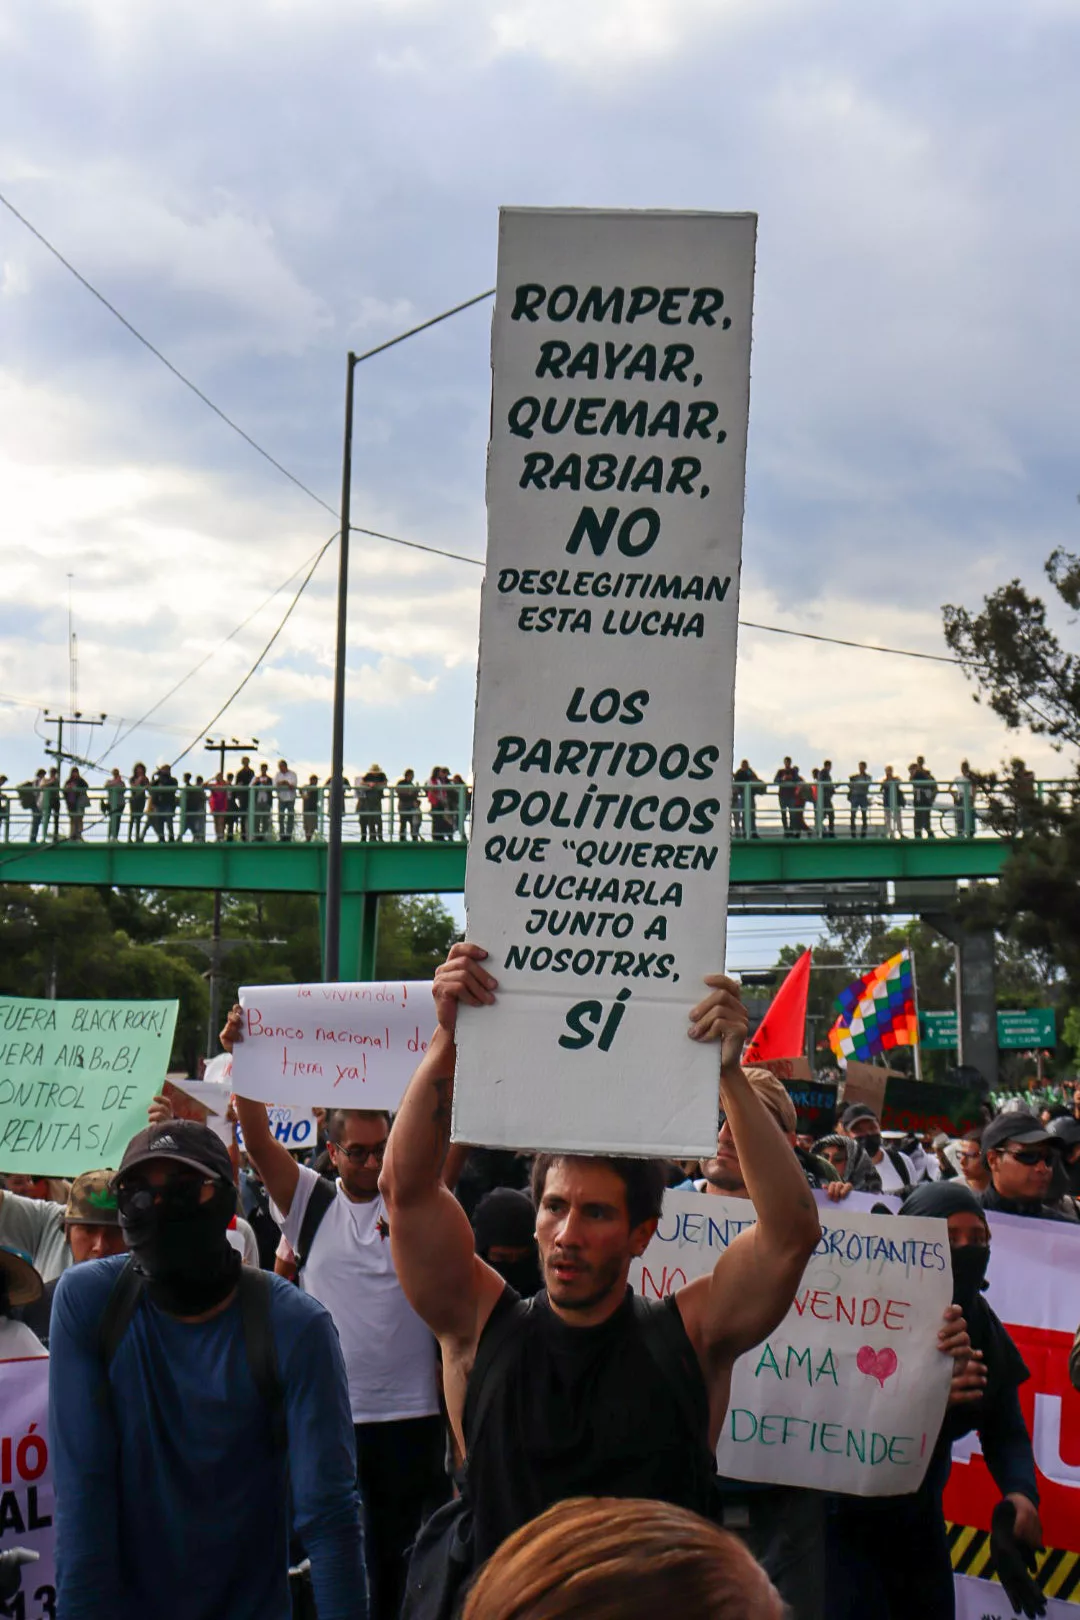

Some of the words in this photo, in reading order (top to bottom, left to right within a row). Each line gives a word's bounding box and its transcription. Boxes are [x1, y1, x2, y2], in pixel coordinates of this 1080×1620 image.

[511, 283, 731, 330] ROMPER,
[535, 340, 702, 387] RAYAR,
[508, 396, 727, 444] QUEMAR,
[519, 452, 710, 499] RABIAR,
[566, 506, 660, 557] NO
[497, 568, 731, 602] DESLEGITIMAN
[518, 606, 591, 633] ESTA
[602, 609, 704, 638] LUCHA
[566, 687, 649, 725] LOS
[492, 736, 719, 780] PARTIDOS
[487, 784, 720, 834] POLÍTICOS
[485, 835, 551, 863] QUE
[515, 873, 683, 907] LUCHARLA
[525, 909, 634, 939] JUNTO
[644, 915, 667, 941] A
[504, 946, 680, 982] NOSOTRXS,
[247, 1008, 304, 1040] Banco
[315, 1027, 390, 1050] nacional
[558, 988, 632, 1052] SÍ
[333, 1052, 367, 1087] ya!
[102, 1086, 137, 1110] DE
[0, 1118, 114, 1157] RENTAS!
[755, 1343, 838, 1387] AMA
